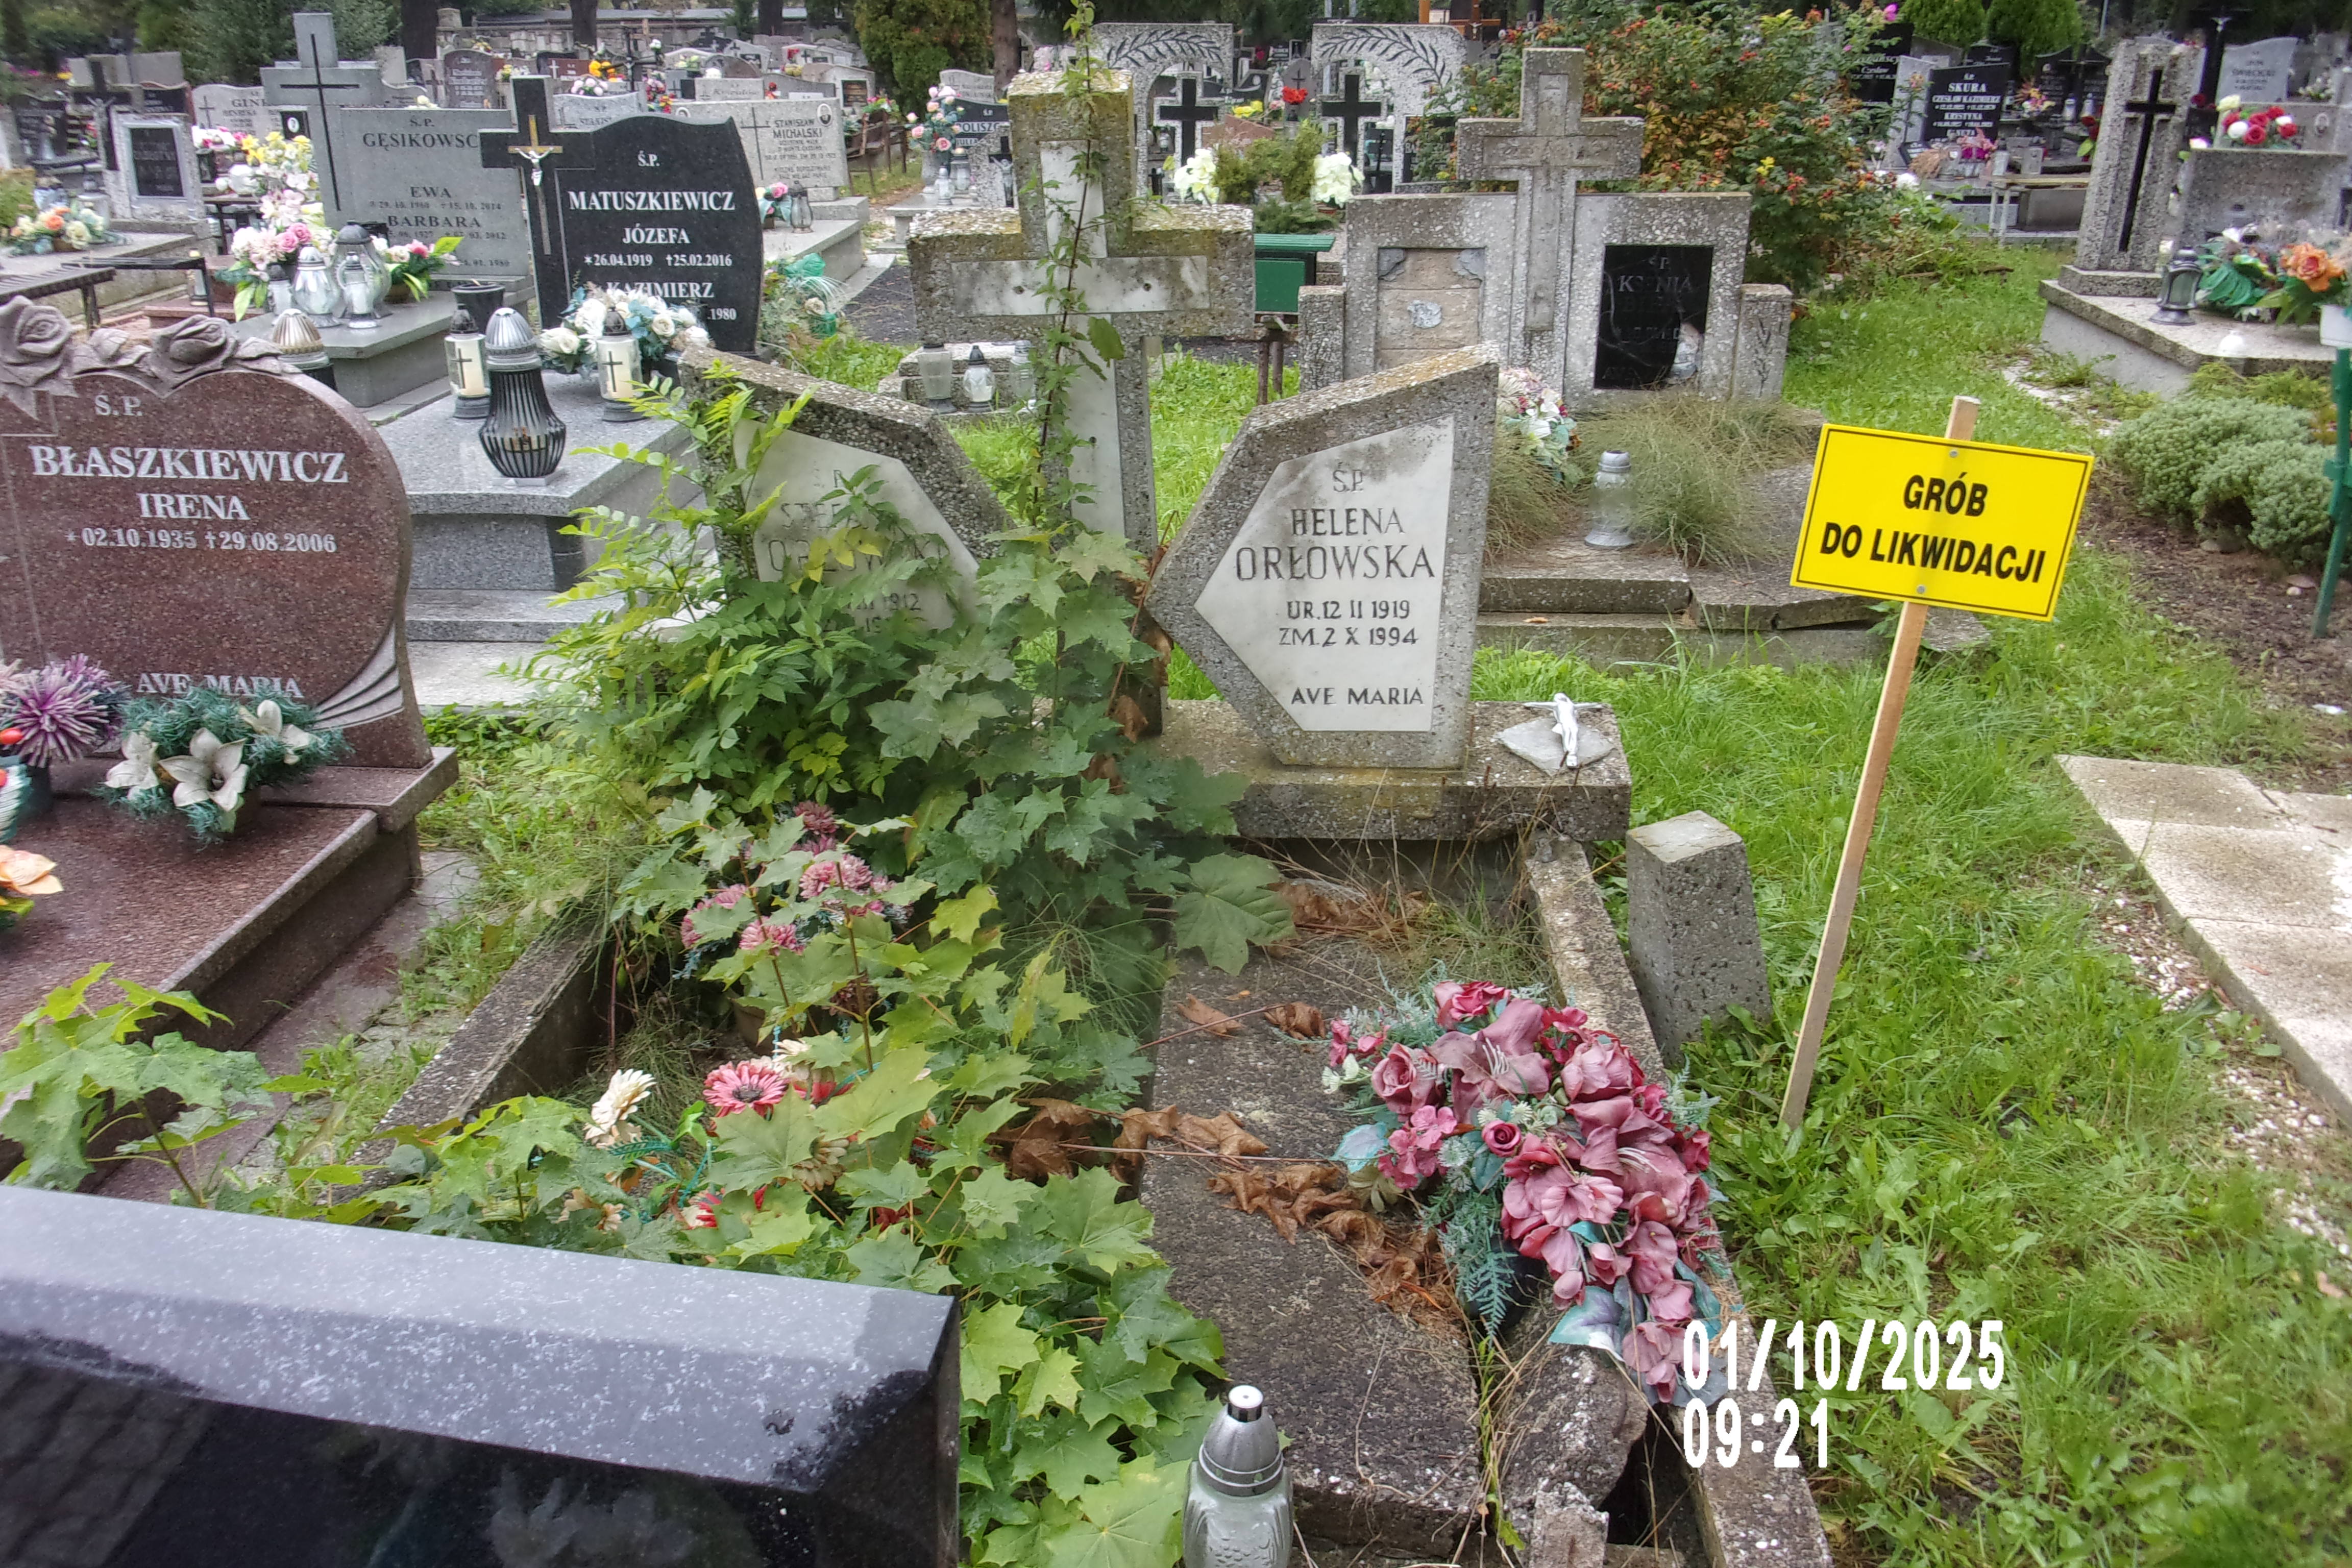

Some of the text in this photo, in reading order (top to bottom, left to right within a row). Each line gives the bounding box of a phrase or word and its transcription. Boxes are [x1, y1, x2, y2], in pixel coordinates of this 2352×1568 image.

[1947, 82, 1987, 92] SKURA
[773, 128, 822, 139] MICHALSKI
[410, 186, 451, 198] EWA
[569, 191, 735, 211] MATUSZKIEWICZ
[387, 215, 481, 228] BARBARA
[622, 223, 690, 244] JÓZEFA
[606, 282, 715, 299] KAZIMIERZ
[29, 445, 349, 484] BŁASZKIEWICZ
[1903, 472, 1989, 517] GRÓB
[137, 493, 250, 521] IRENA
[1291, 508, 1404, 537] HELENA
[1236, 544, 1435, 581] ORŁOWSKA
[1820, 522, 2047, 583] DO LIKWIDACJI
[1351, 600, 1362, 619] II
[1371, 600, 1410, 619] 1919
[1344, 628, 1359, 646] X
[1369, 627, 1419, 646] 1994
[137, 672, 304, 698] AVE MARIA
[1291, 687, 1423, 705] AVE MARIA
